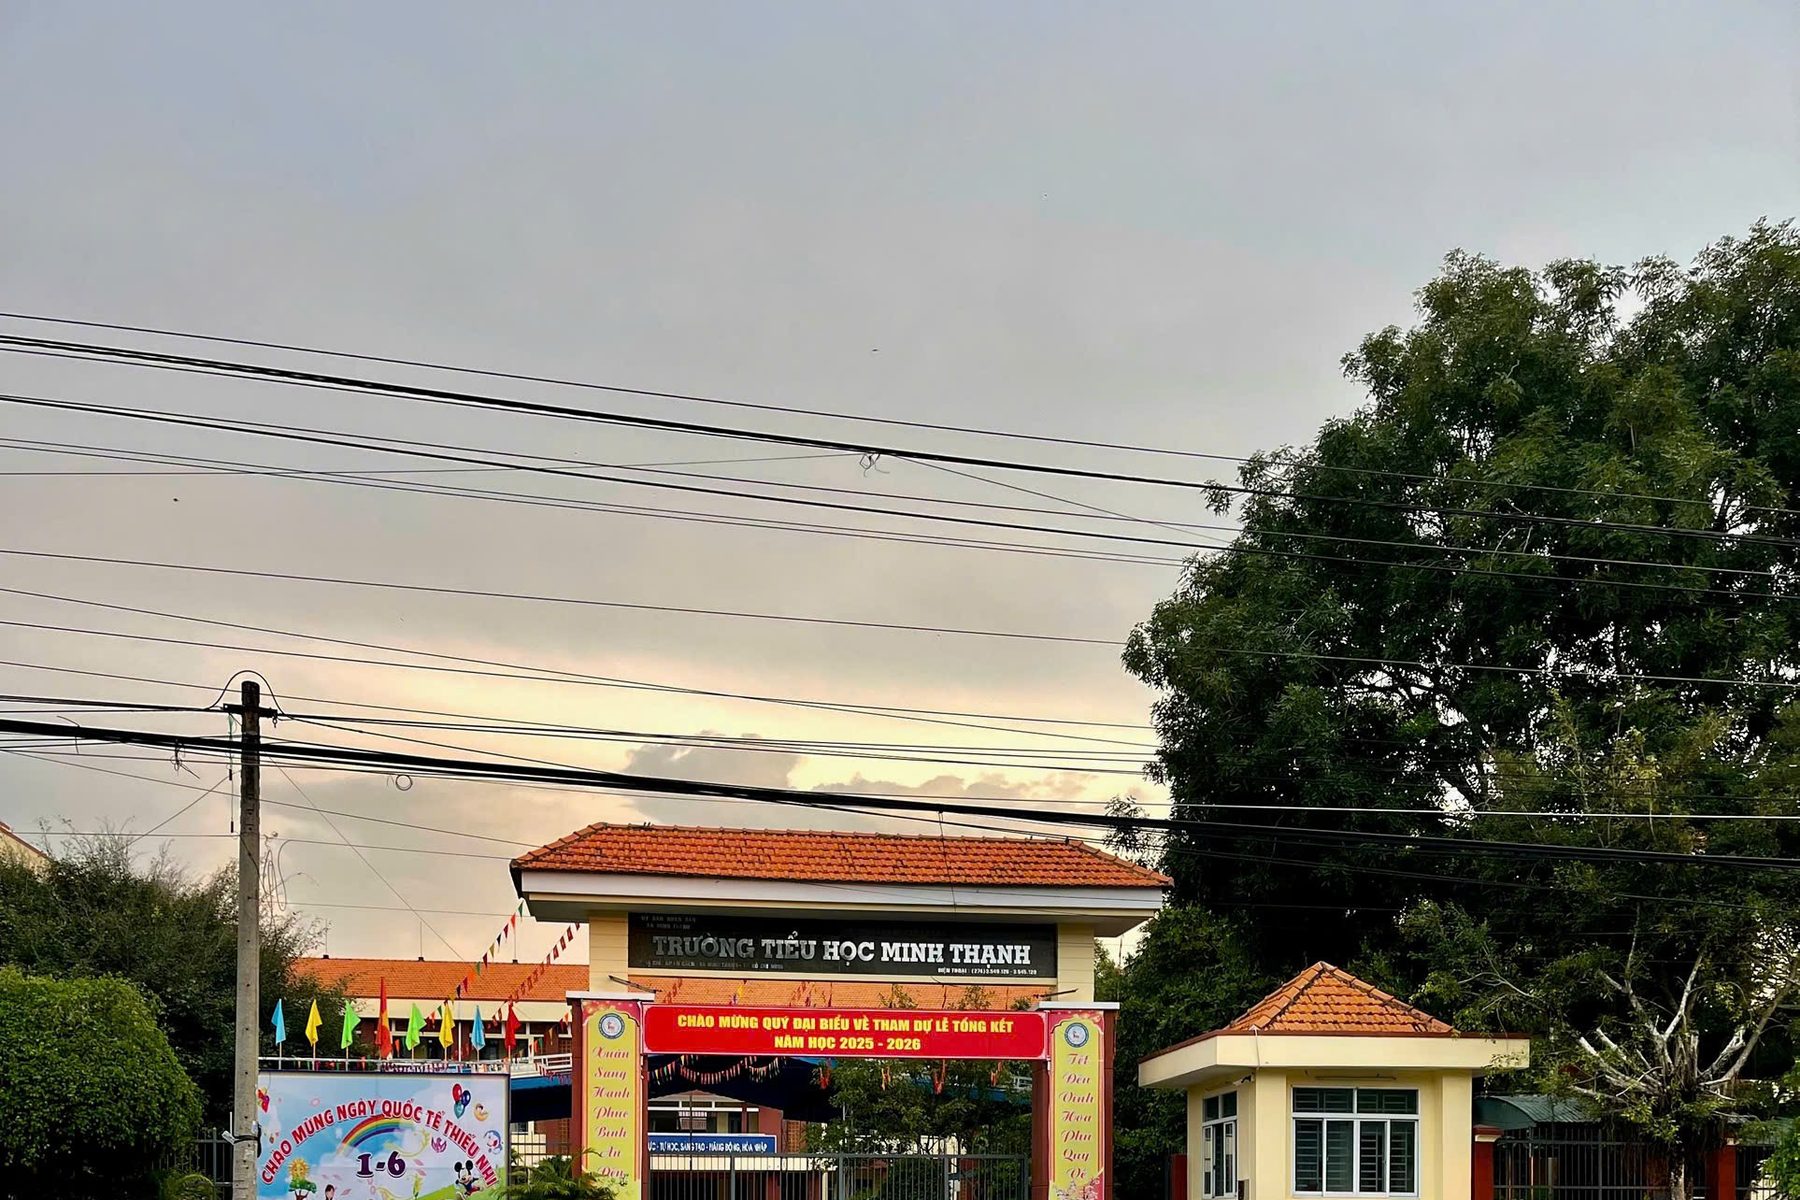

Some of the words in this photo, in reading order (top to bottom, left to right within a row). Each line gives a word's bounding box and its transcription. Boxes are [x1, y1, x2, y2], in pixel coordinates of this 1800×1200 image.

[653, 933, 755, 958] TRƯỜNG
[761, 931, 816, 959] TIỂU
[823, 941, 874, 966] HỌC
[881, 942, 944, 963] MINH
[950, 944, 1030, 968] THẠNH
[677, 1013, 715, 1028] CHÀO
[718, 1014, 759, 1029] MỪNG
[762, 1015, 790, 1030] QUÝ
[793, 1017, 816, 1032] ĐẠI
[819, 1014, 850, 1030] BIỂU
[853, 1015, 869, 1031] VỀ
[872, 1018, 910, 1032] THAM
[913, 1018, 934, 1034] DỰ
[990, 1017, 1014, 1033] KẾT
[774, 1034, 804, 1049] NĂM
[808, 1036, 836, 1051] HỌC
[839, 1037, 874, 1050] 2025
[886, 1038, 921, 1050] 2026
[262, 1140, 292, 1183] CHÀO
[336, 1099, 377, 1121] NGÀY
[382, 1099, 423, 1121] QUỐC
[425, 1110, 446, 1130] TẾ
[443, 1119, 480, 1158] THIẾU
[475, 1154, 498, 1186] NHI
[356, 1151, 406, 1178] 1-6
